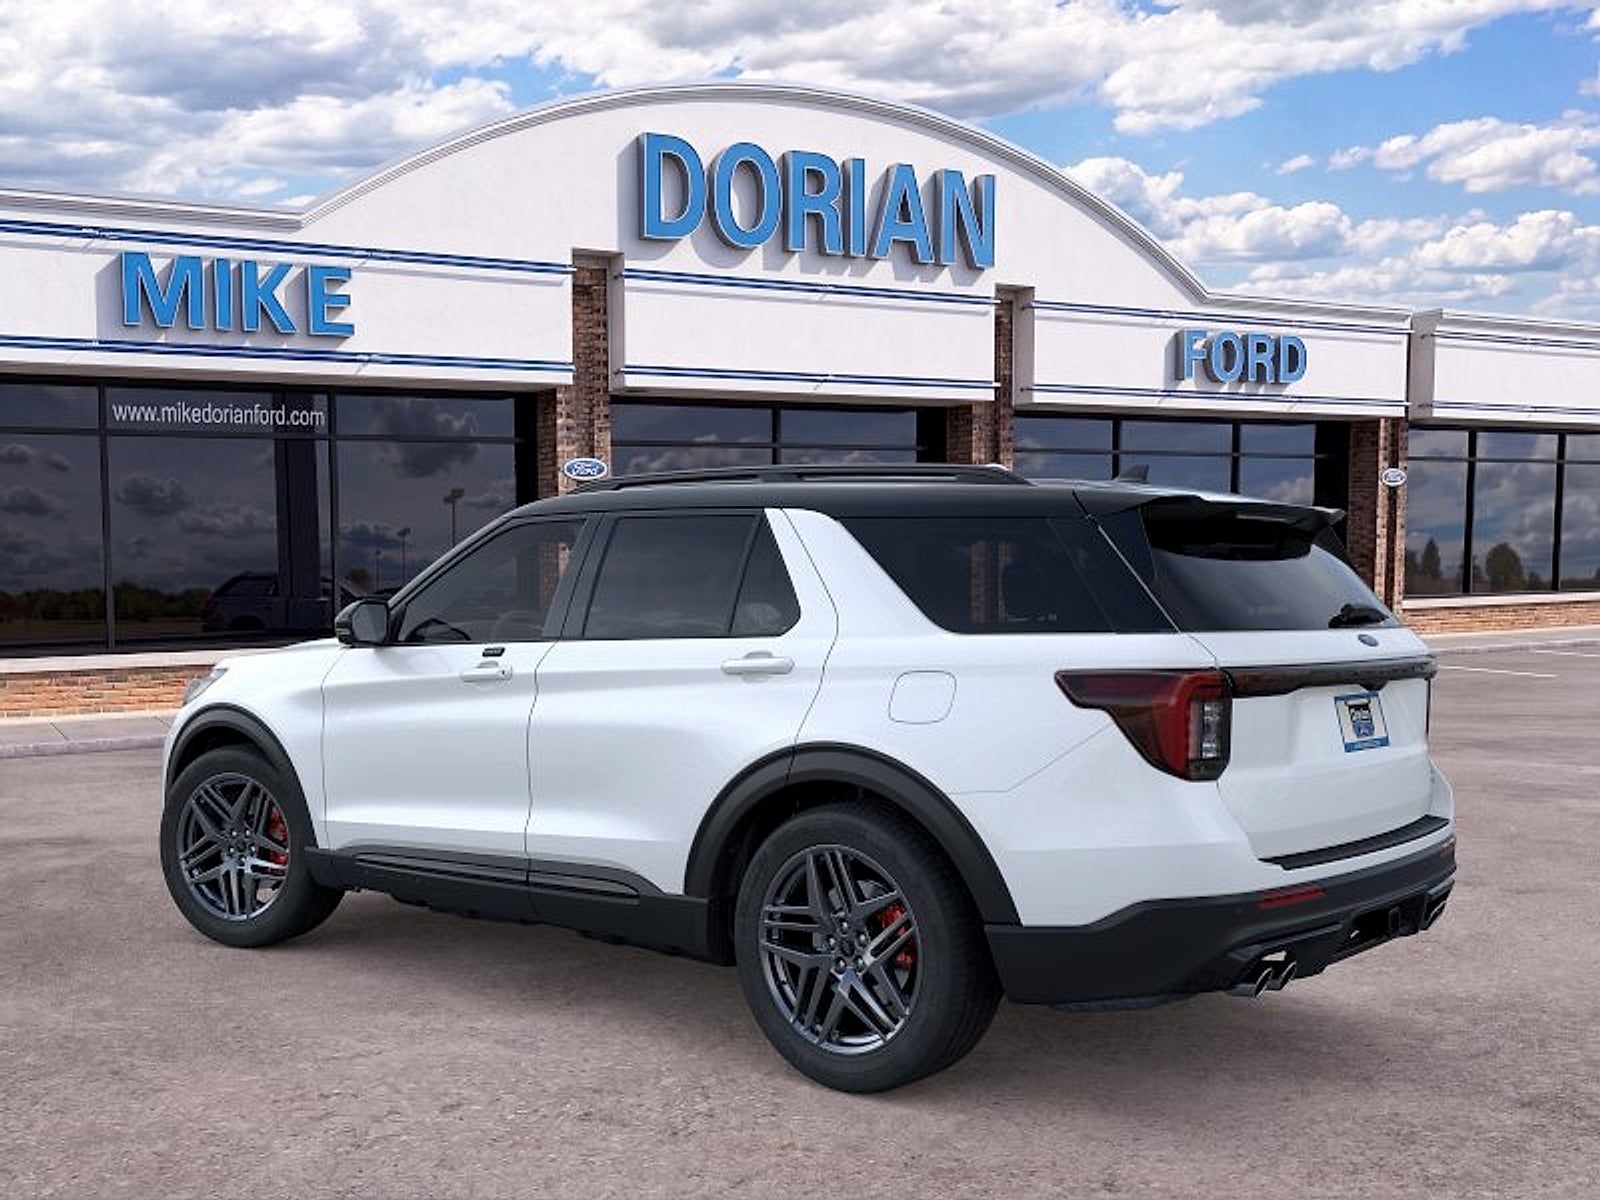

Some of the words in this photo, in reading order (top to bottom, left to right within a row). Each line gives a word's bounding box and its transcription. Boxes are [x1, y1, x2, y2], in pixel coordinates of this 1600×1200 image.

[641, 132, 996, 269] DORIAN
[122, 251, 355, 338] MIKE
[1180, 328, 1308, 383] FORD
[111, 402, 326, 427] www.mikedorianford.com
